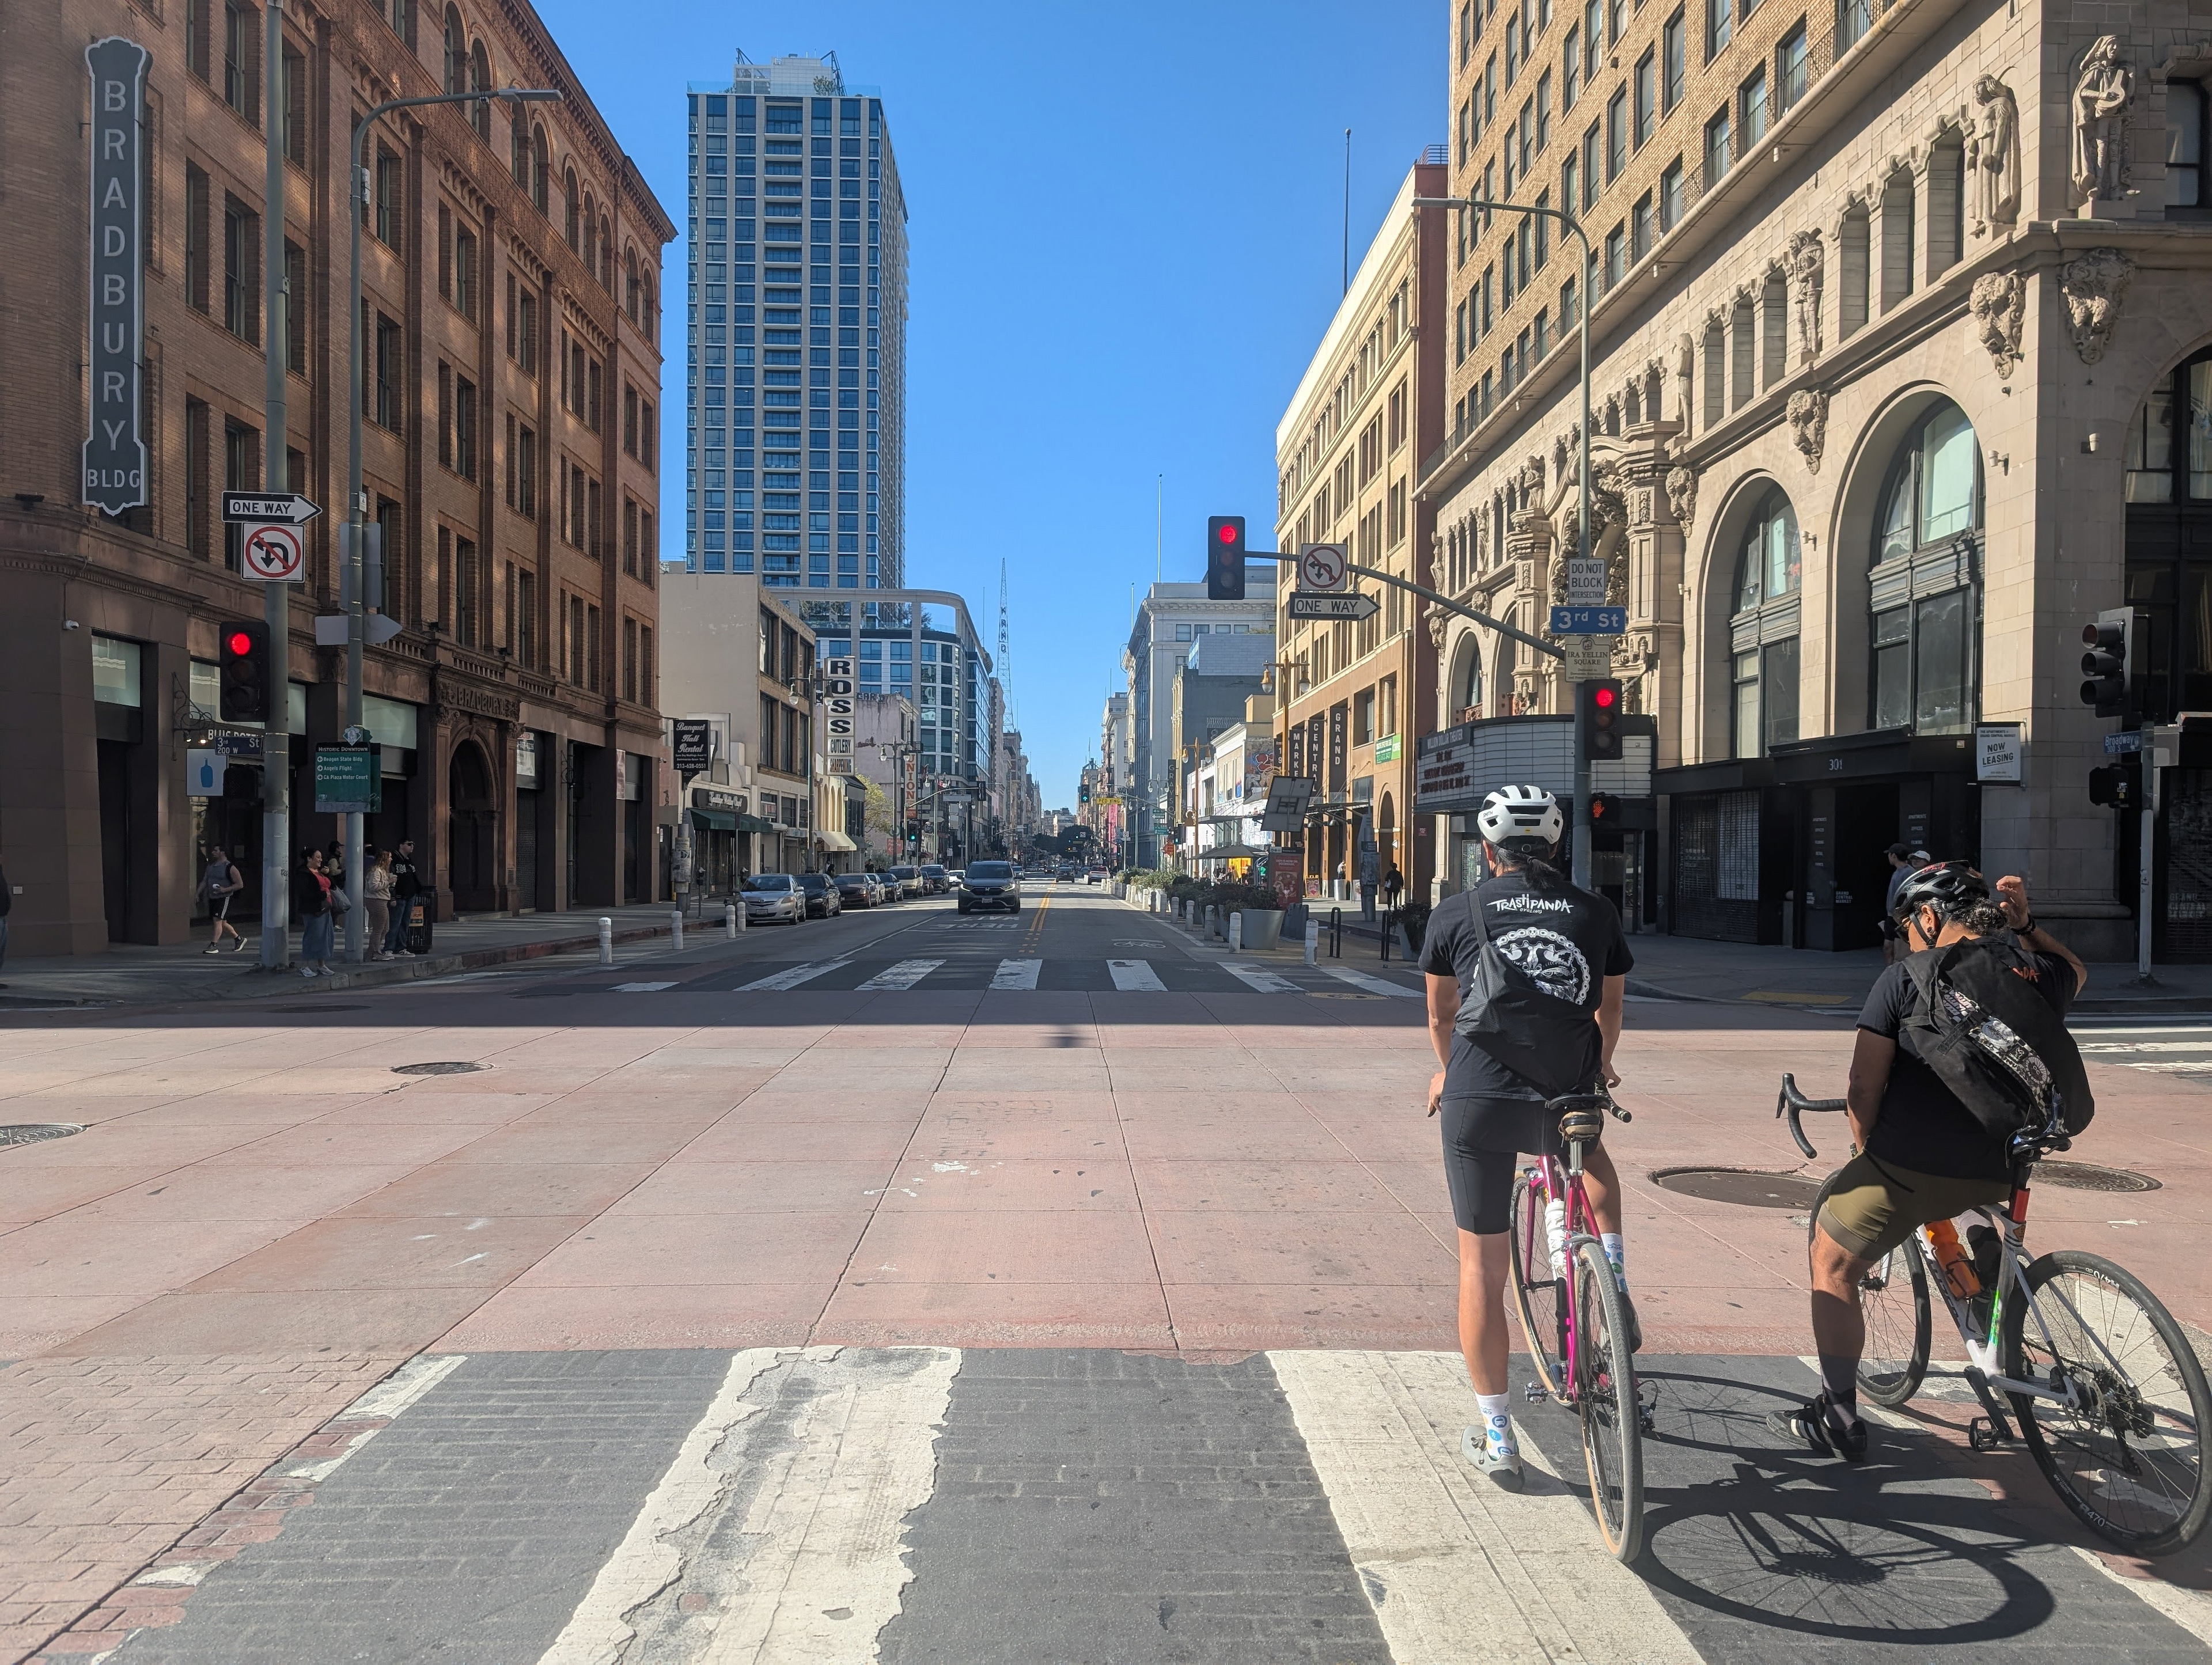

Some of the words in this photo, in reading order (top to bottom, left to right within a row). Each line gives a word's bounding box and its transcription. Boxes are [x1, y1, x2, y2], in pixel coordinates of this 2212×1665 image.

[103, 81, 127, 451] BRADBURY
[88, 469, 141, 488] BLDG
[233, 502, 259, 513] ONE
[264, 503, 291, 514] WAY
[1571, 564, 1584, 574] DO
[1586, 564, 1603, 574] NOT
[1571, 577, 1603, 587] BLOCK
[1296, 600, 1321, 612] ONE
[1331, 601, 1358, 613] WAY
[1558, 611, 1588, 629] 3rd
[1598, 613, 1618, 627] St
[830, 660, 851, 733] ROSS
[676, 722, 706, 733] Banquet
[217, 738, 229, 747] 3rd
[249, 738, 259, 748] St
[681, 734, 700, 742] Hall
[1427, 737, 1438, 750] MILLION
[1438, 733, 1449, 746] DOLLAR
[1449, 729, 1463, 743] THEATER
[2105, 735, 2134, 746] Broadway
[677, 743, 704, 753] Rental
[830, 739, 851, 753] CUTLERY
[1987, 742, 2005, 753] NOW
[1829, 758, 1843, 770] 301
[1982, 752, 2014, 765] LEASING
[906, 754, 915, 799] UNION
[1486, 893, 1574, 914] TRASHPANDA
